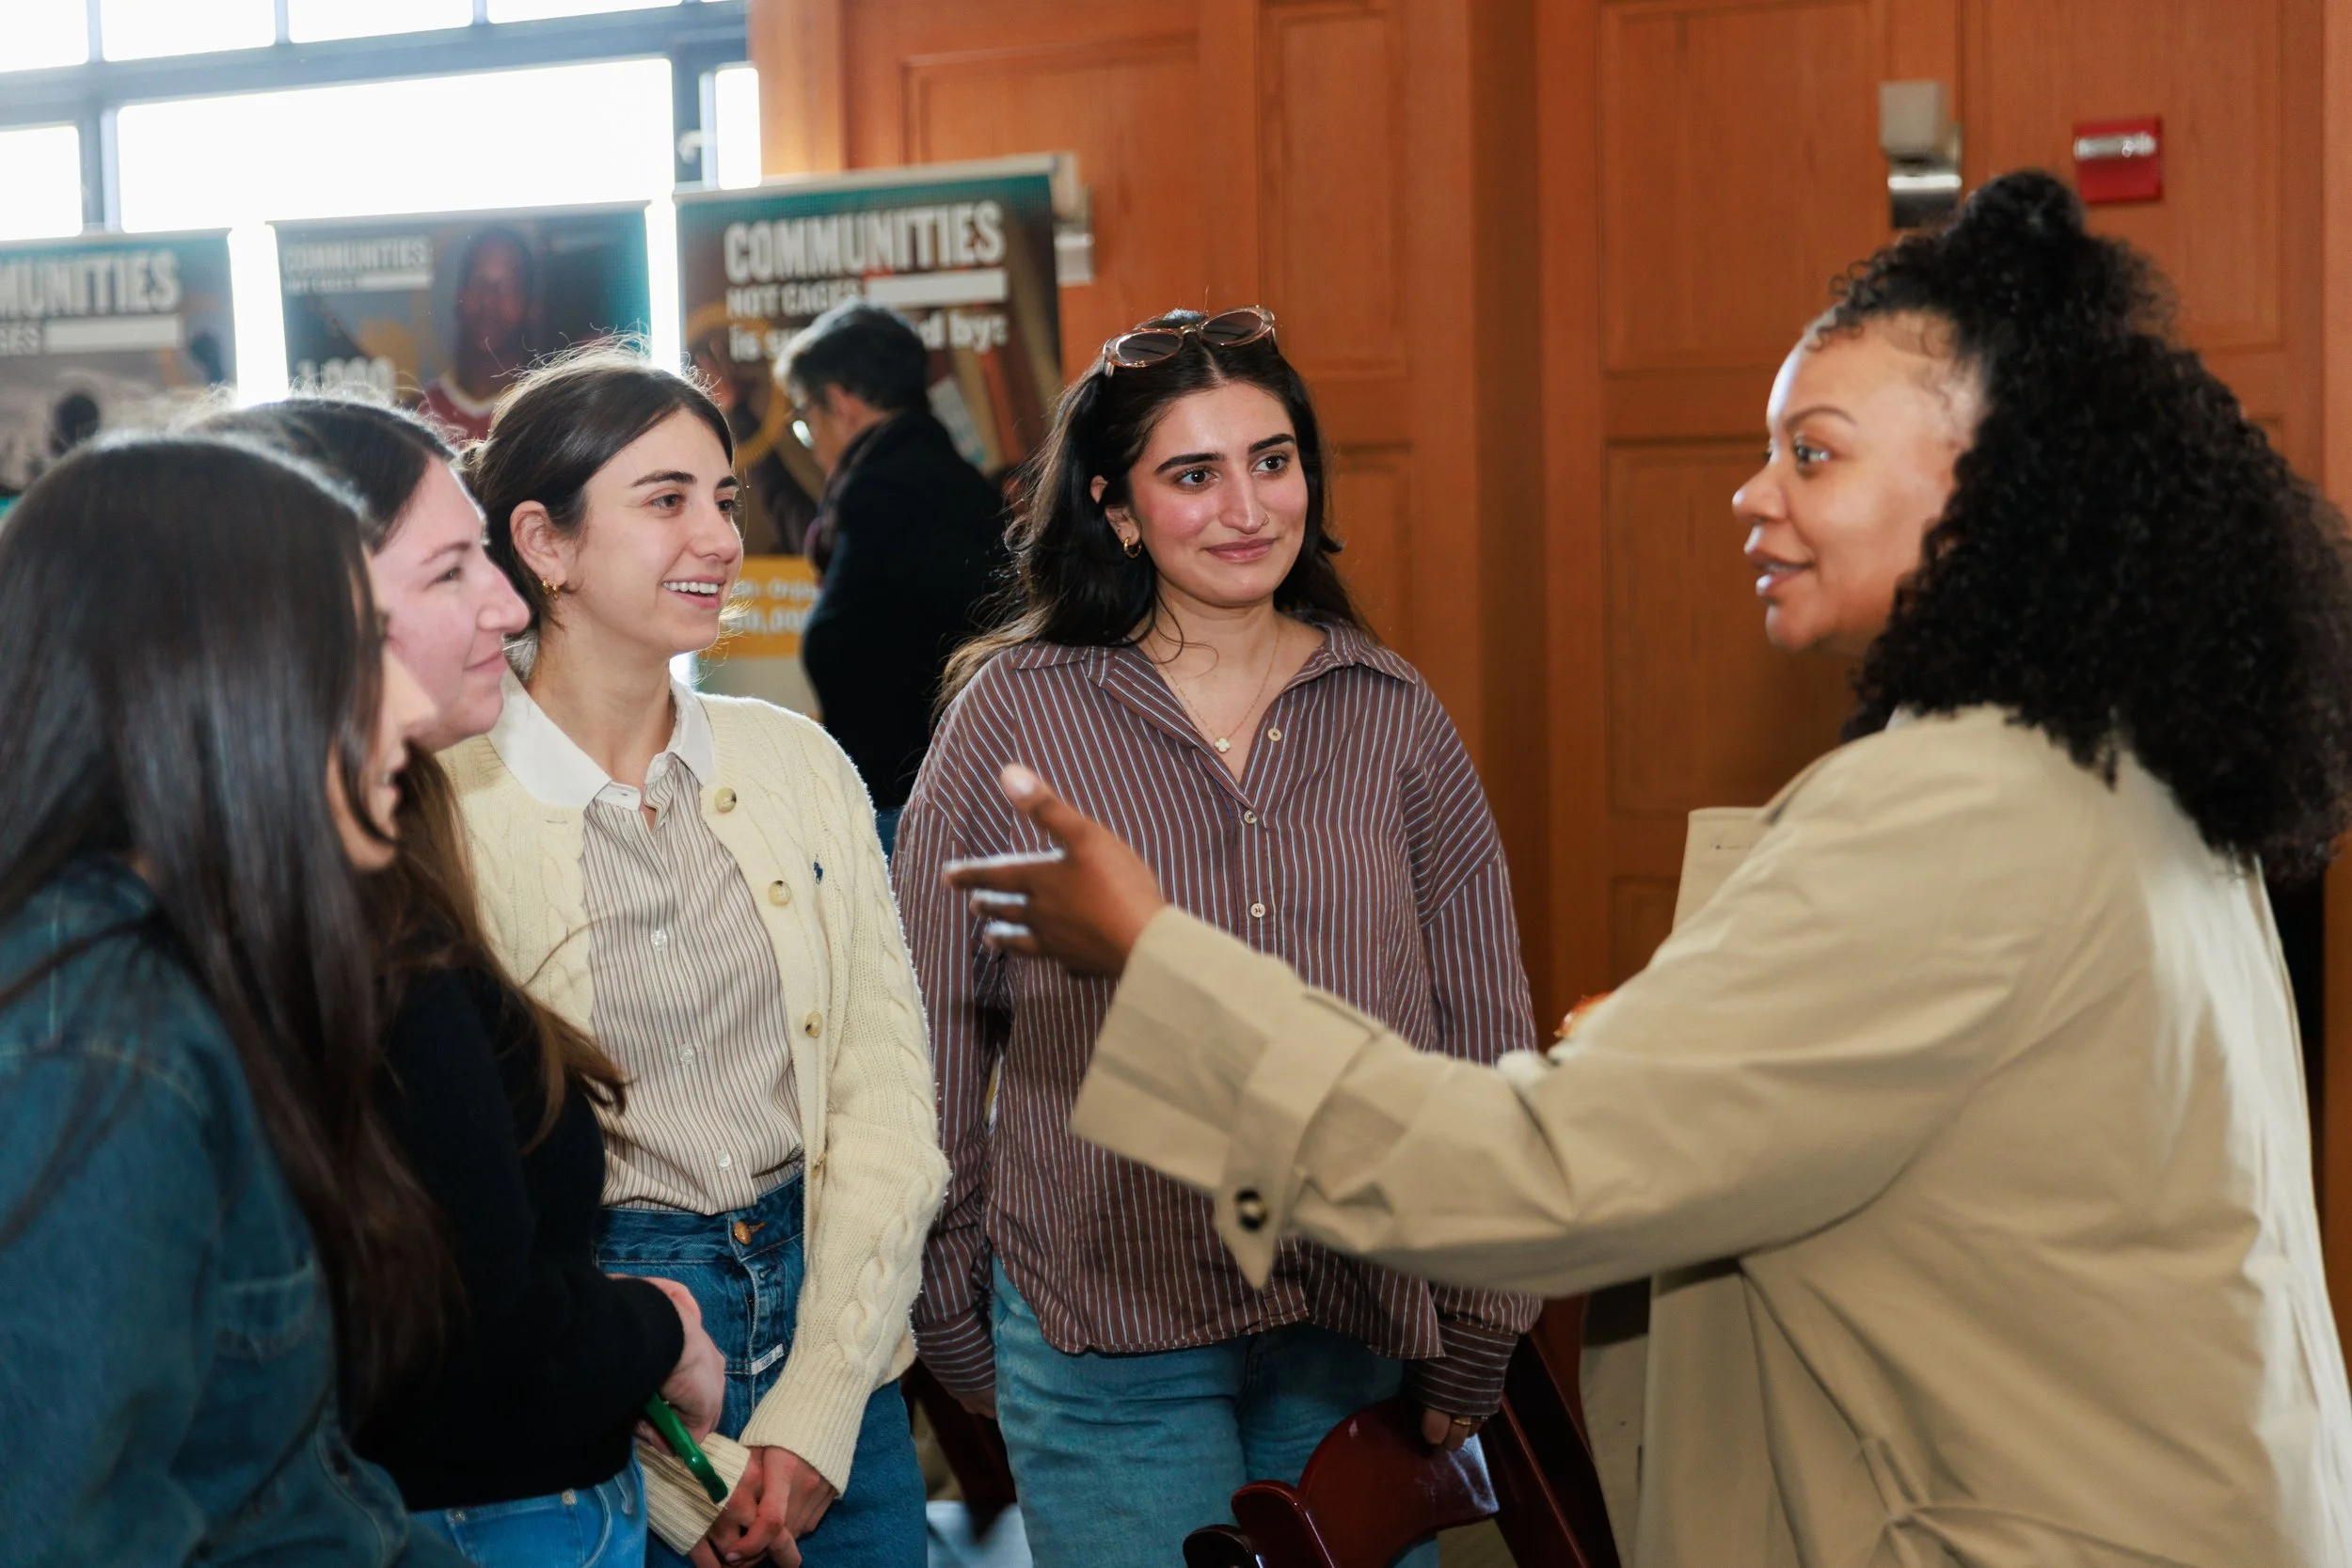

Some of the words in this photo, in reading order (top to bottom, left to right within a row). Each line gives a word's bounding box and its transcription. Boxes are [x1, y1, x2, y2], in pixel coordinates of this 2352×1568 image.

[283, 237, 432, 269] COMMUNITIES
[724, 199, 1005, 283] COMMUNITIES
[725, 284, 780, 318] NOT
